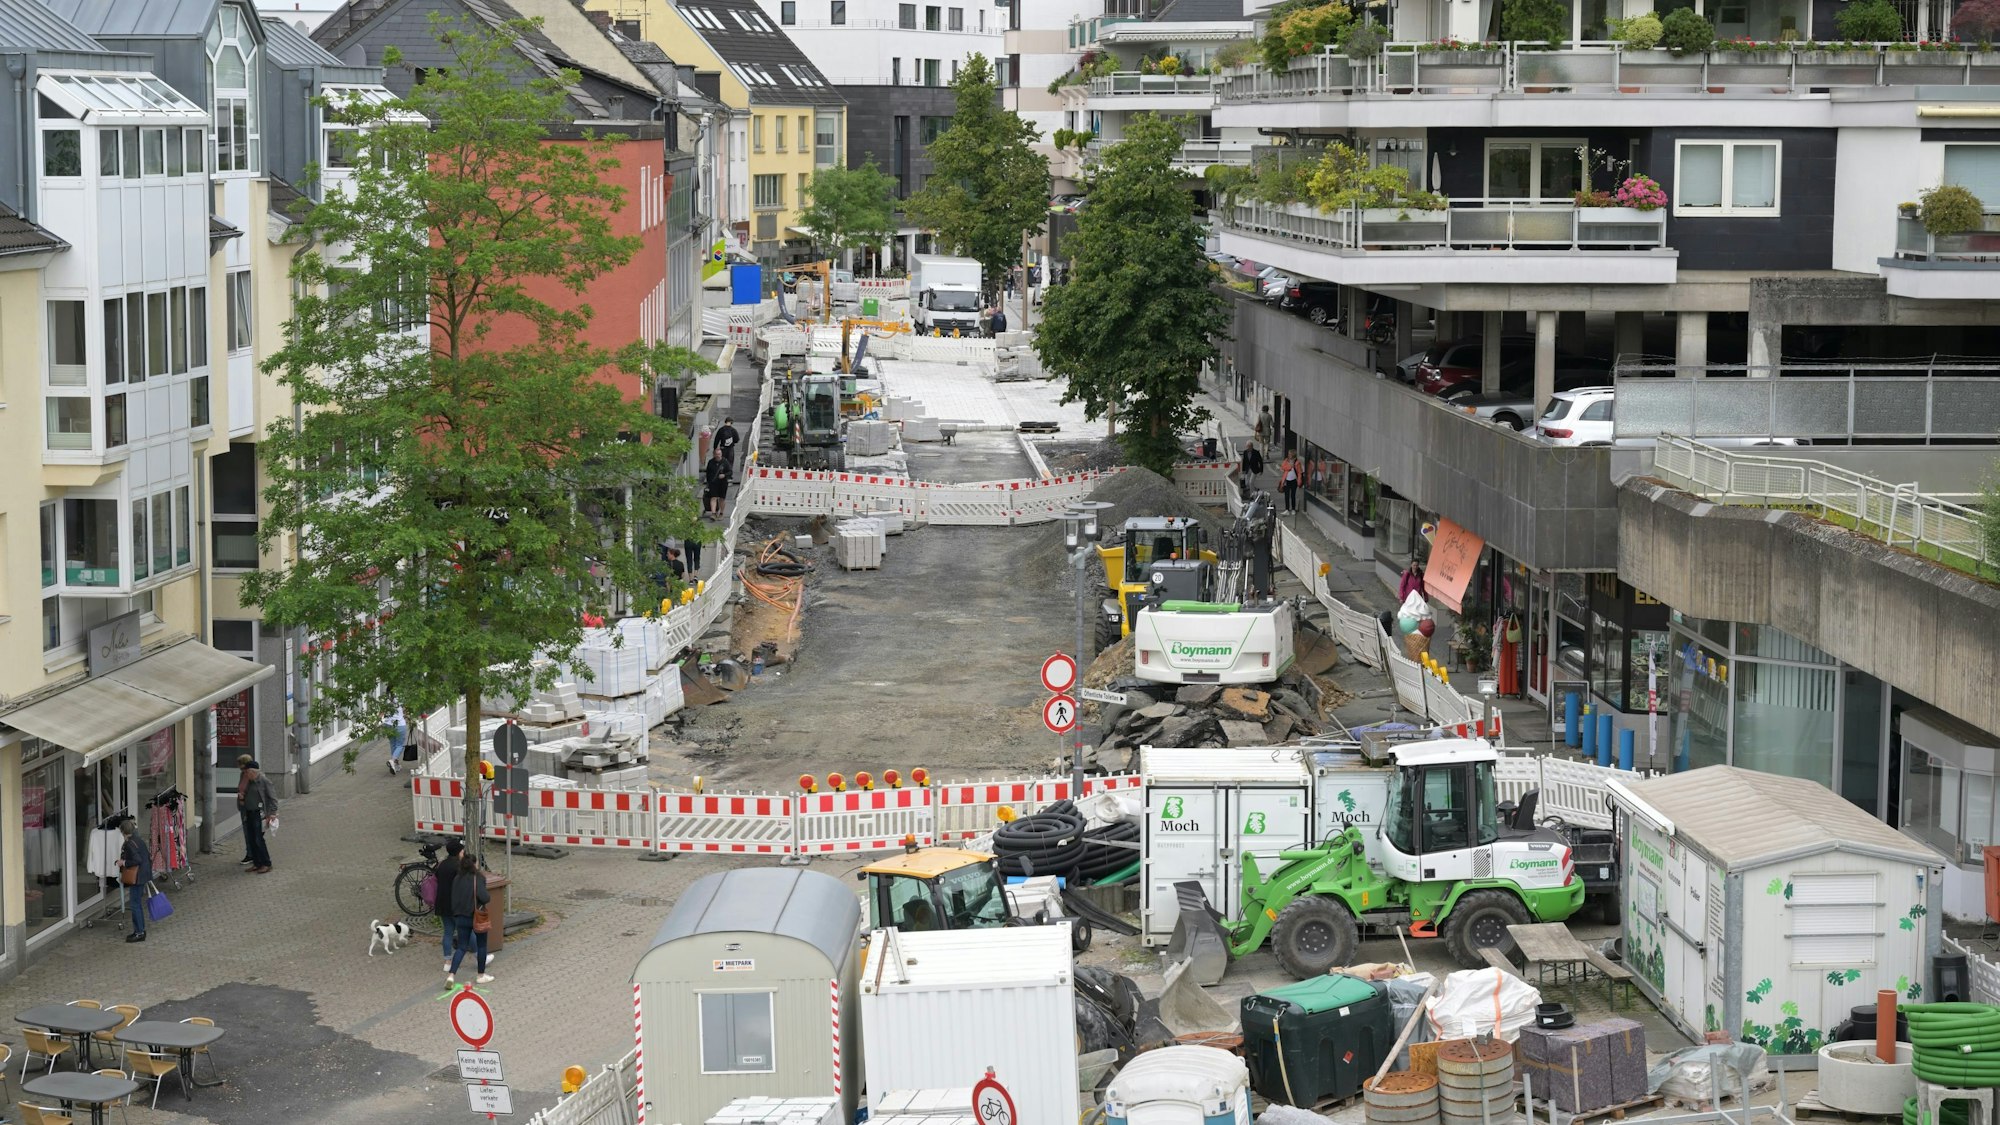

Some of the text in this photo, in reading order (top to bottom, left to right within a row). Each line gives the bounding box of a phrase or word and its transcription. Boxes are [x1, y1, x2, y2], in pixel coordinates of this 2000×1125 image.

[1635, 588, 1661, 604] EL
[1171, 641, 1232, 657] Boymann
[1331, 811, 1370, 823] Moch
[1160, 820, 1200, 832] Moch
[1632, 824, 1664, 870] Boymann
[1510, 858, 1558, 870] Boymann
[951, 871, 980, 884] VOLVO
[1287, 857, 1335, 890] www.boymann.de
[478, 1058, 500, 1066] Wende-
[466, 1066, 497, 1074] möglichkeit
